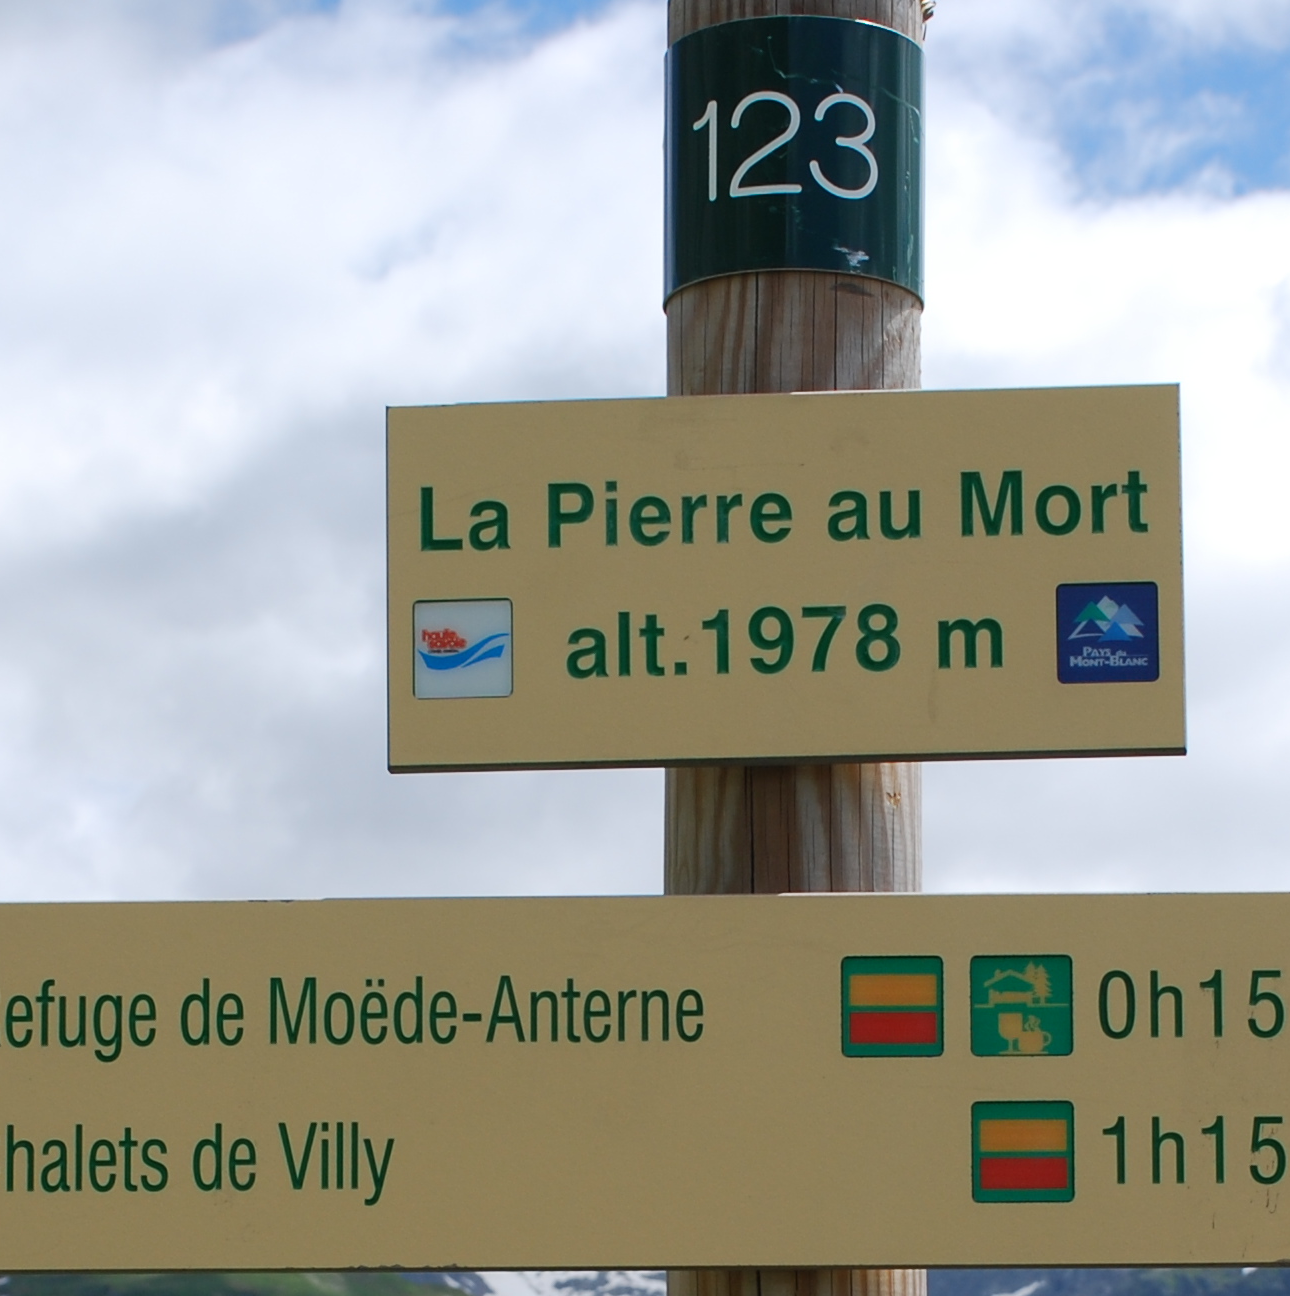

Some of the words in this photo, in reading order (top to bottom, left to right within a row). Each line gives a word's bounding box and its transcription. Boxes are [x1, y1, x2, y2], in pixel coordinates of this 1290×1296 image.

[692, 90, 879, 201] 123
[420, 486, 511, 552] La
[547, 480, 793, 549] Pierre
[827, 489, 921, 542] au
[960, 469, 1149, 537] Mort
[937, 617, 1003, 669] m
[1069, 655, 1149, 667] MONT-BLANC
[1083, 646, 1111, 657] PAYS
[180, 977, 244, 1047] de
[269, 974, 704, 1046] Moëde-Anterne
[1098, 969, 1285, 1040] 0h15
[192, 1122, 257, 1192] de
[278, 1121, 395, 1207] Villy
[1102, 1115, 1287, 1185] 1h15
